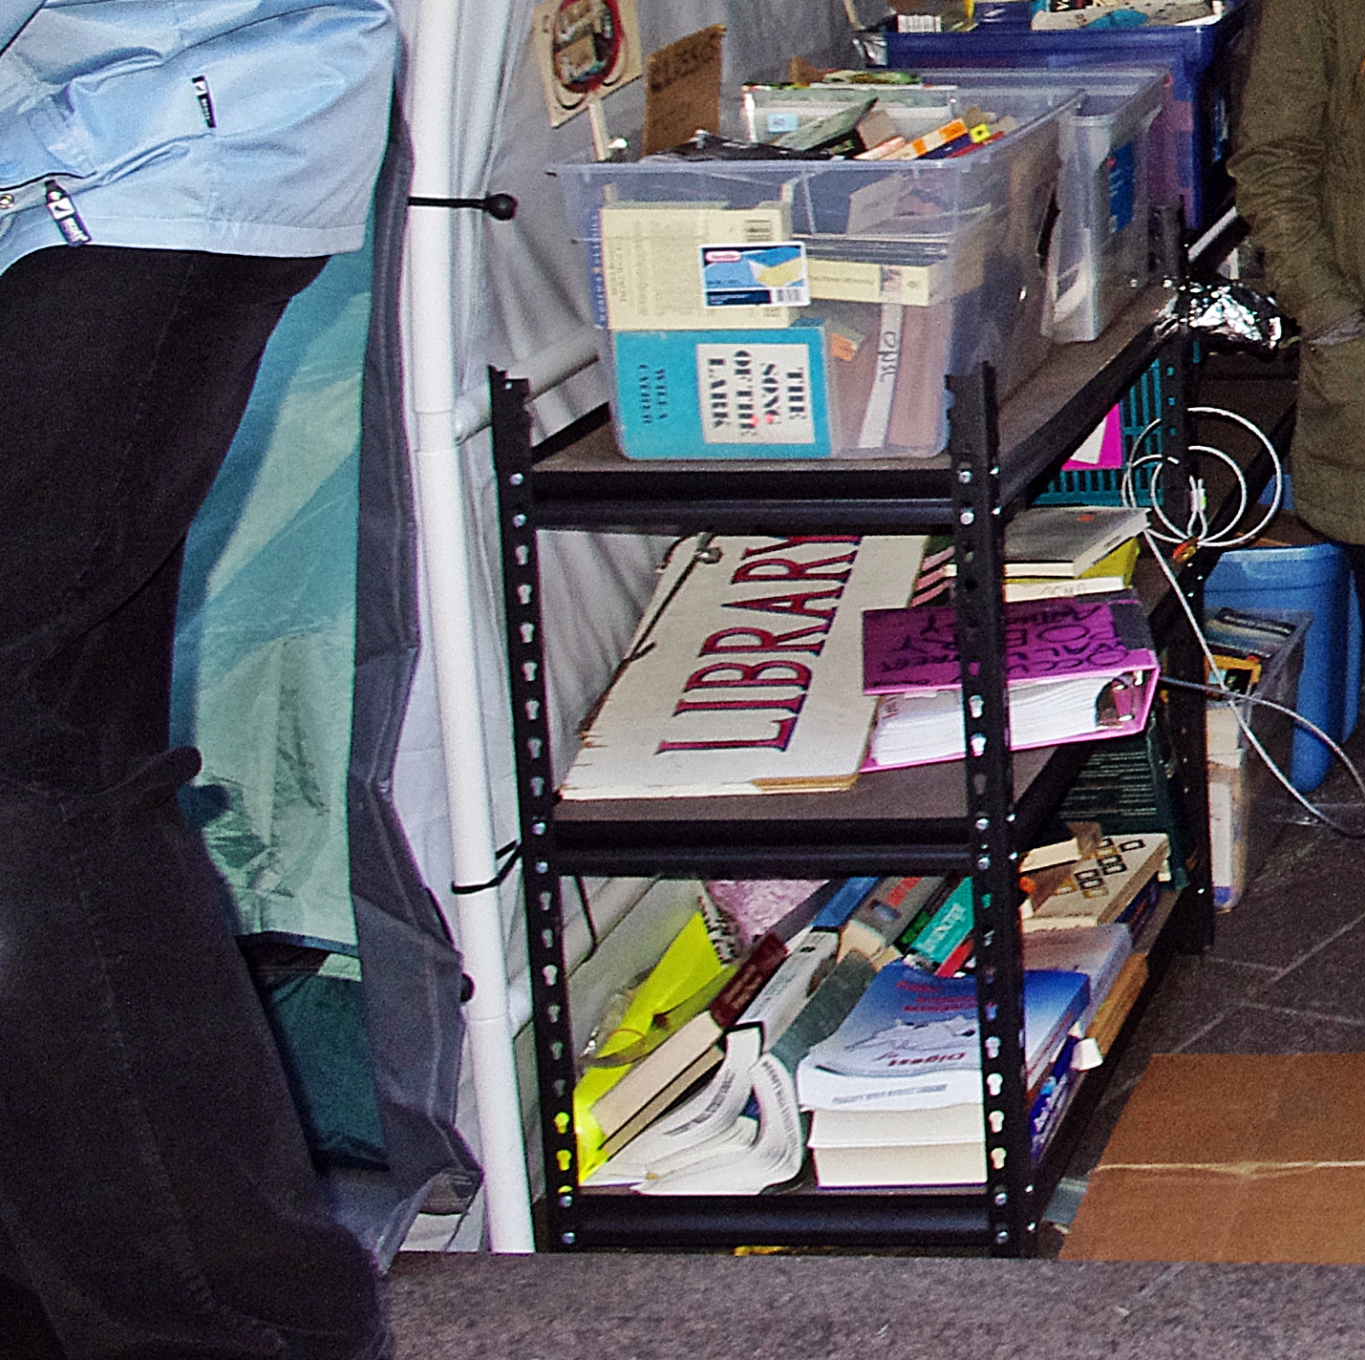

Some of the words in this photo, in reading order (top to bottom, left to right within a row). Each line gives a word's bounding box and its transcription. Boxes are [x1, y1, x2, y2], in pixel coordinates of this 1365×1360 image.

[733, 349, 754, 384] OF
[707, 357, 732, 431] LARK
[736, 388, 758, 438] THE
[760, 361, 782, 426] SONG
[786, 365, 808, 422] THE
[888, 1051, 967, 1068] Digest
